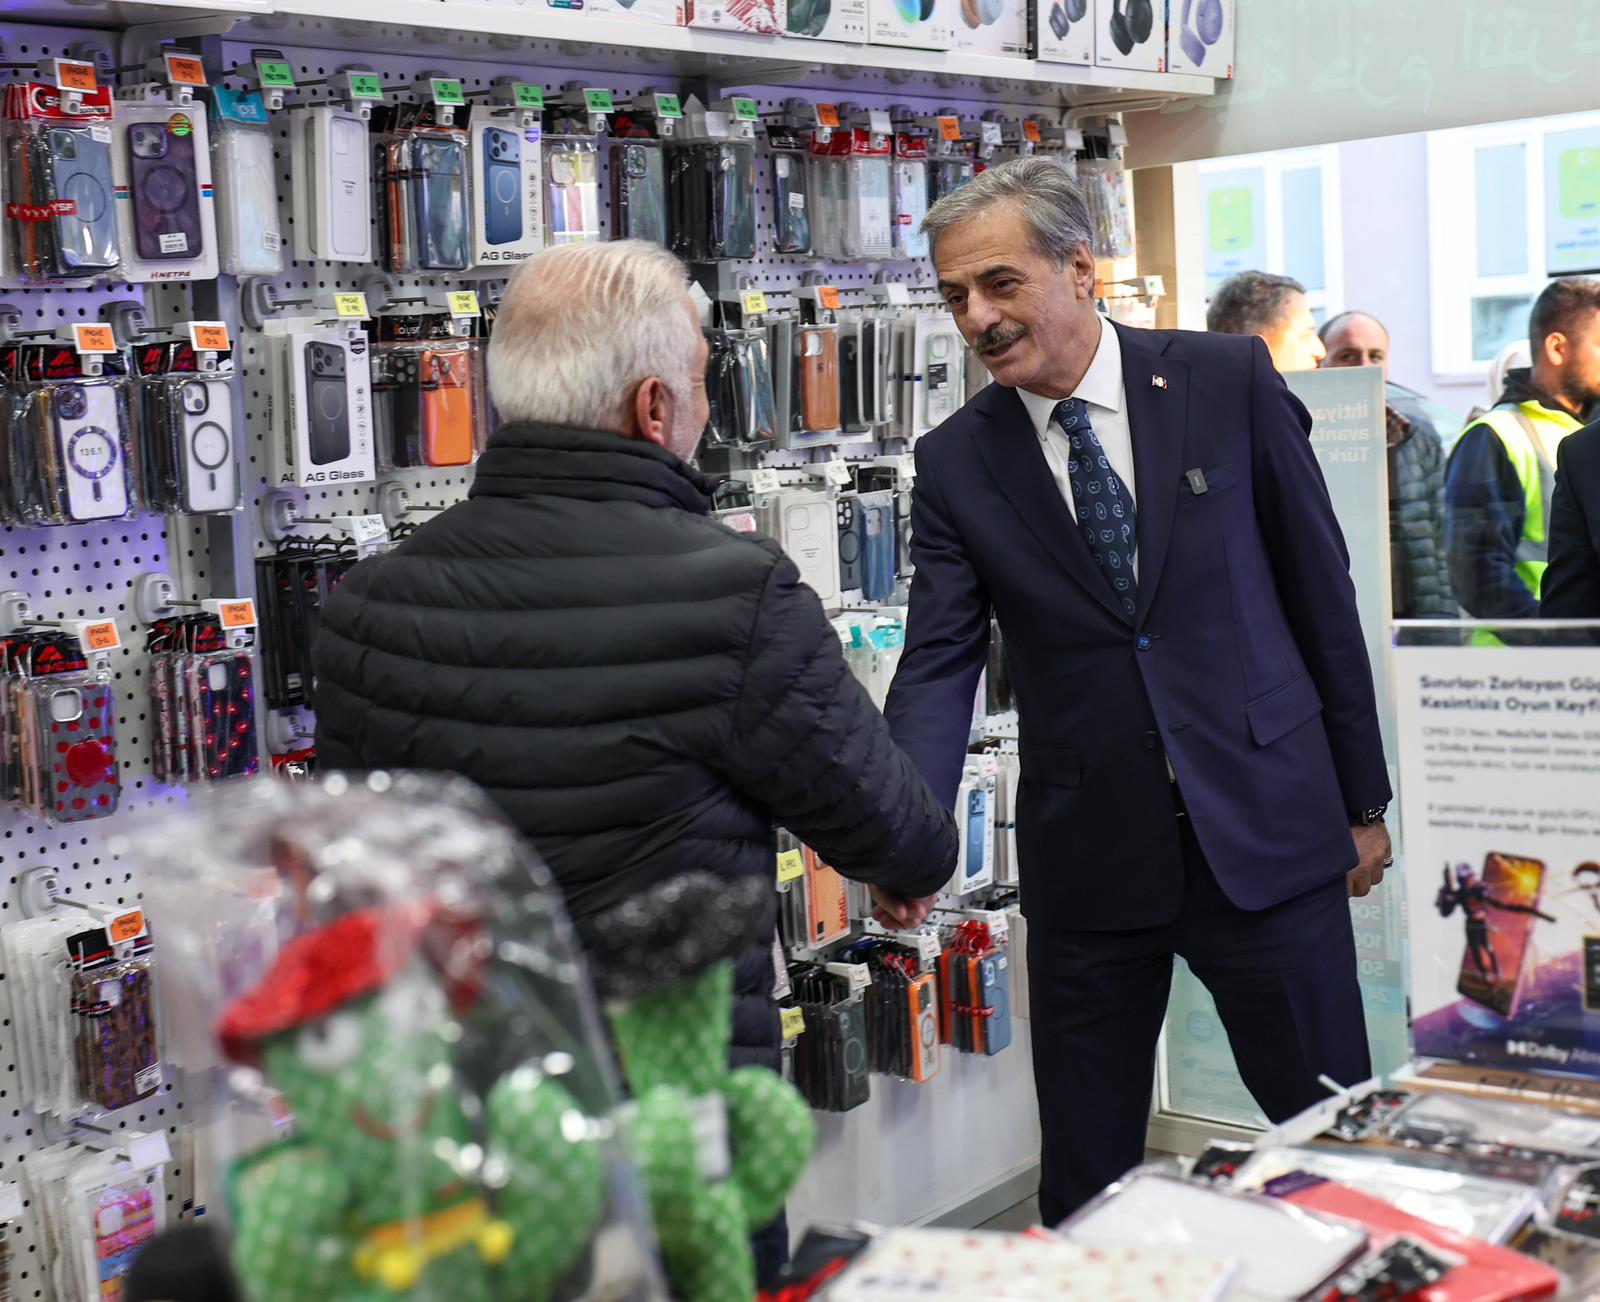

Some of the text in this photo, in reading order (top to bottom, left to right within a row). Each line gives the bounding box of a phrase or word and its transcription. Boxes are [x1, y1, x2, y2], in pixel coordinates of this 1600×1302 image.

[52, 203, 73, 212] YSF
[480, 252, 499, 261] AG
[305, 469, 364, 482] AG Glass
[1506, 697, 1552, 713] Oyun
[1527, 1042, 1569, 1064] Dolby
